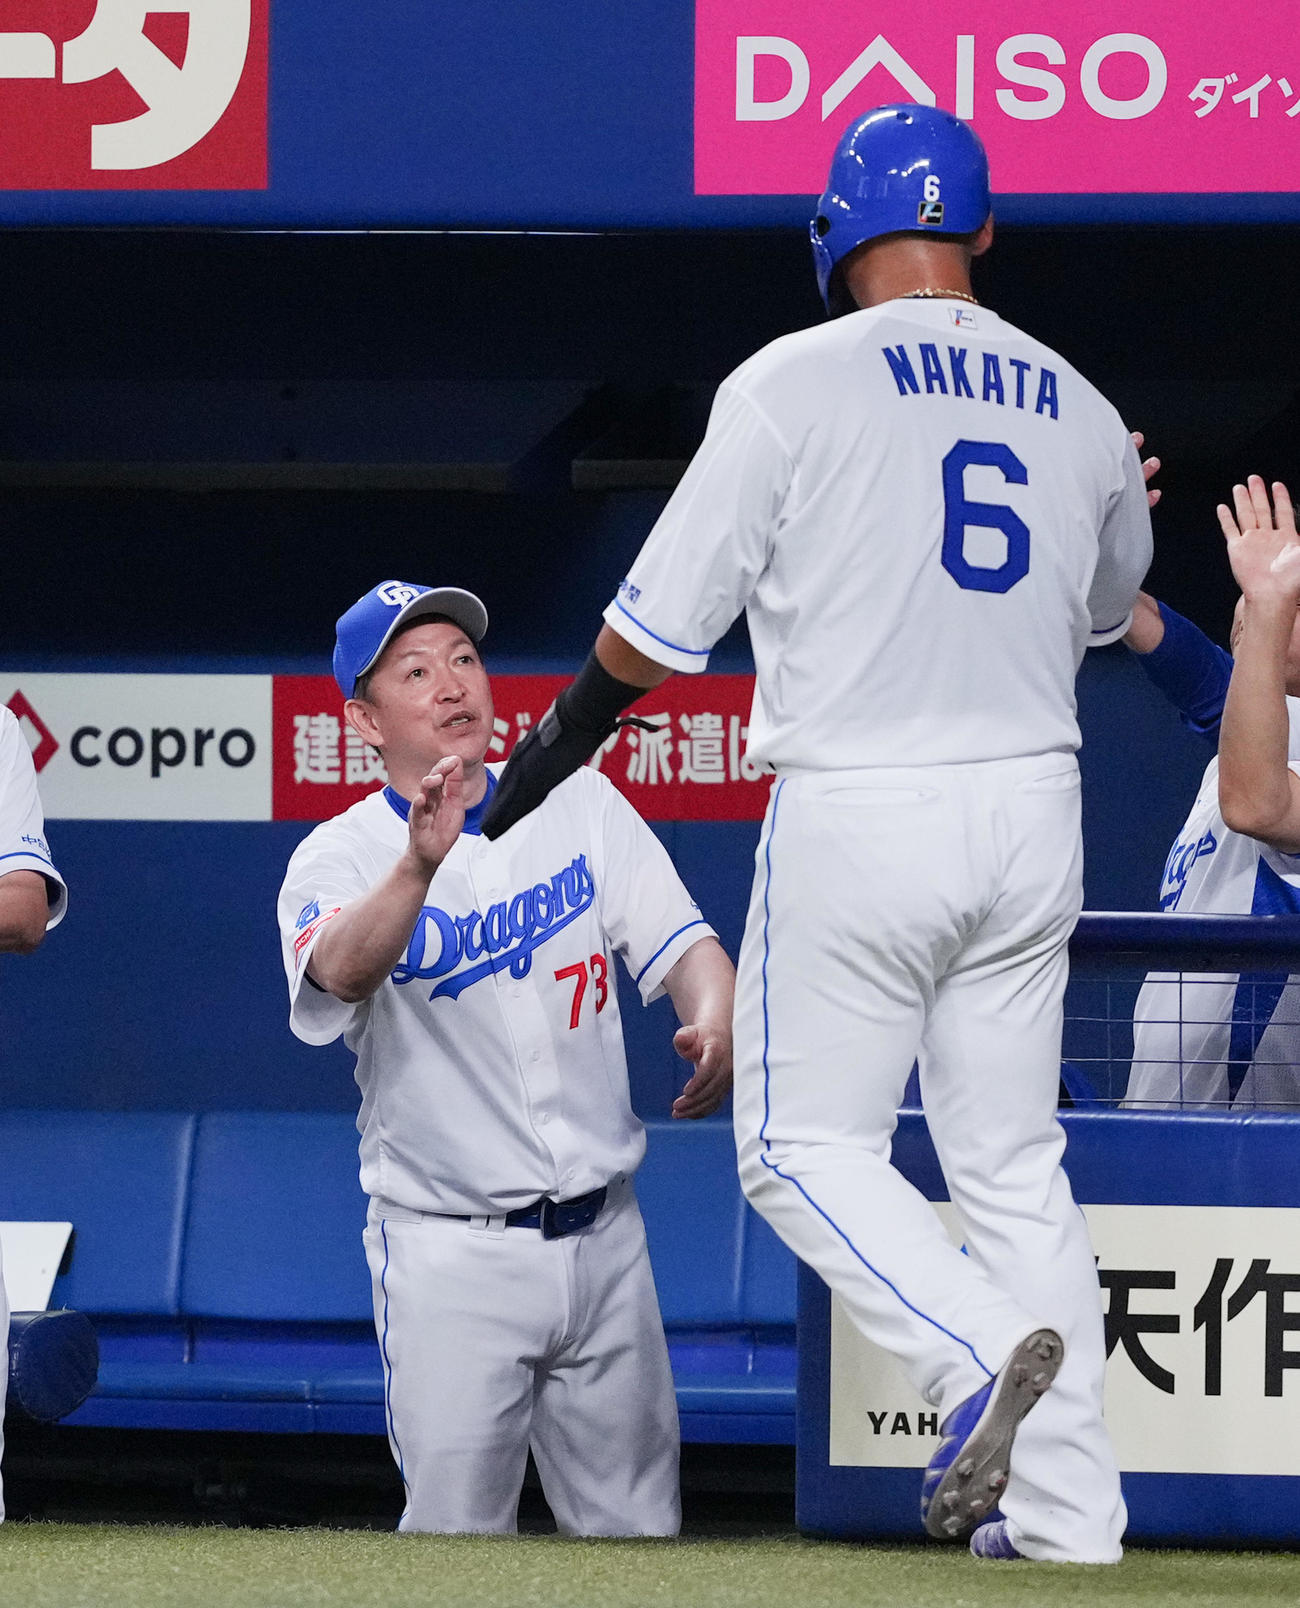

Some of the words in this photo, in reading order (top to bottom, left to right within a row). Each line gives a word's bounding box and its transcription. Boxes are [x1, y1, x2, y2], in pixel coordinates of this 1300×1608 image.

[736, 33, 1168, 122] DAISO
[1188, 72, 1300, 118] ダイソ
[924, 174, 941, 202] 6
[881, 343, 1059, 421] NAKATA
[941, 438, 1031, 594] 6
[70, 725, 256, 778] copro
[391, 853, 594, 1002] Dragons
[554, 953, 608, 1030] 73
[867, 1411, 938, 1436] YAH
